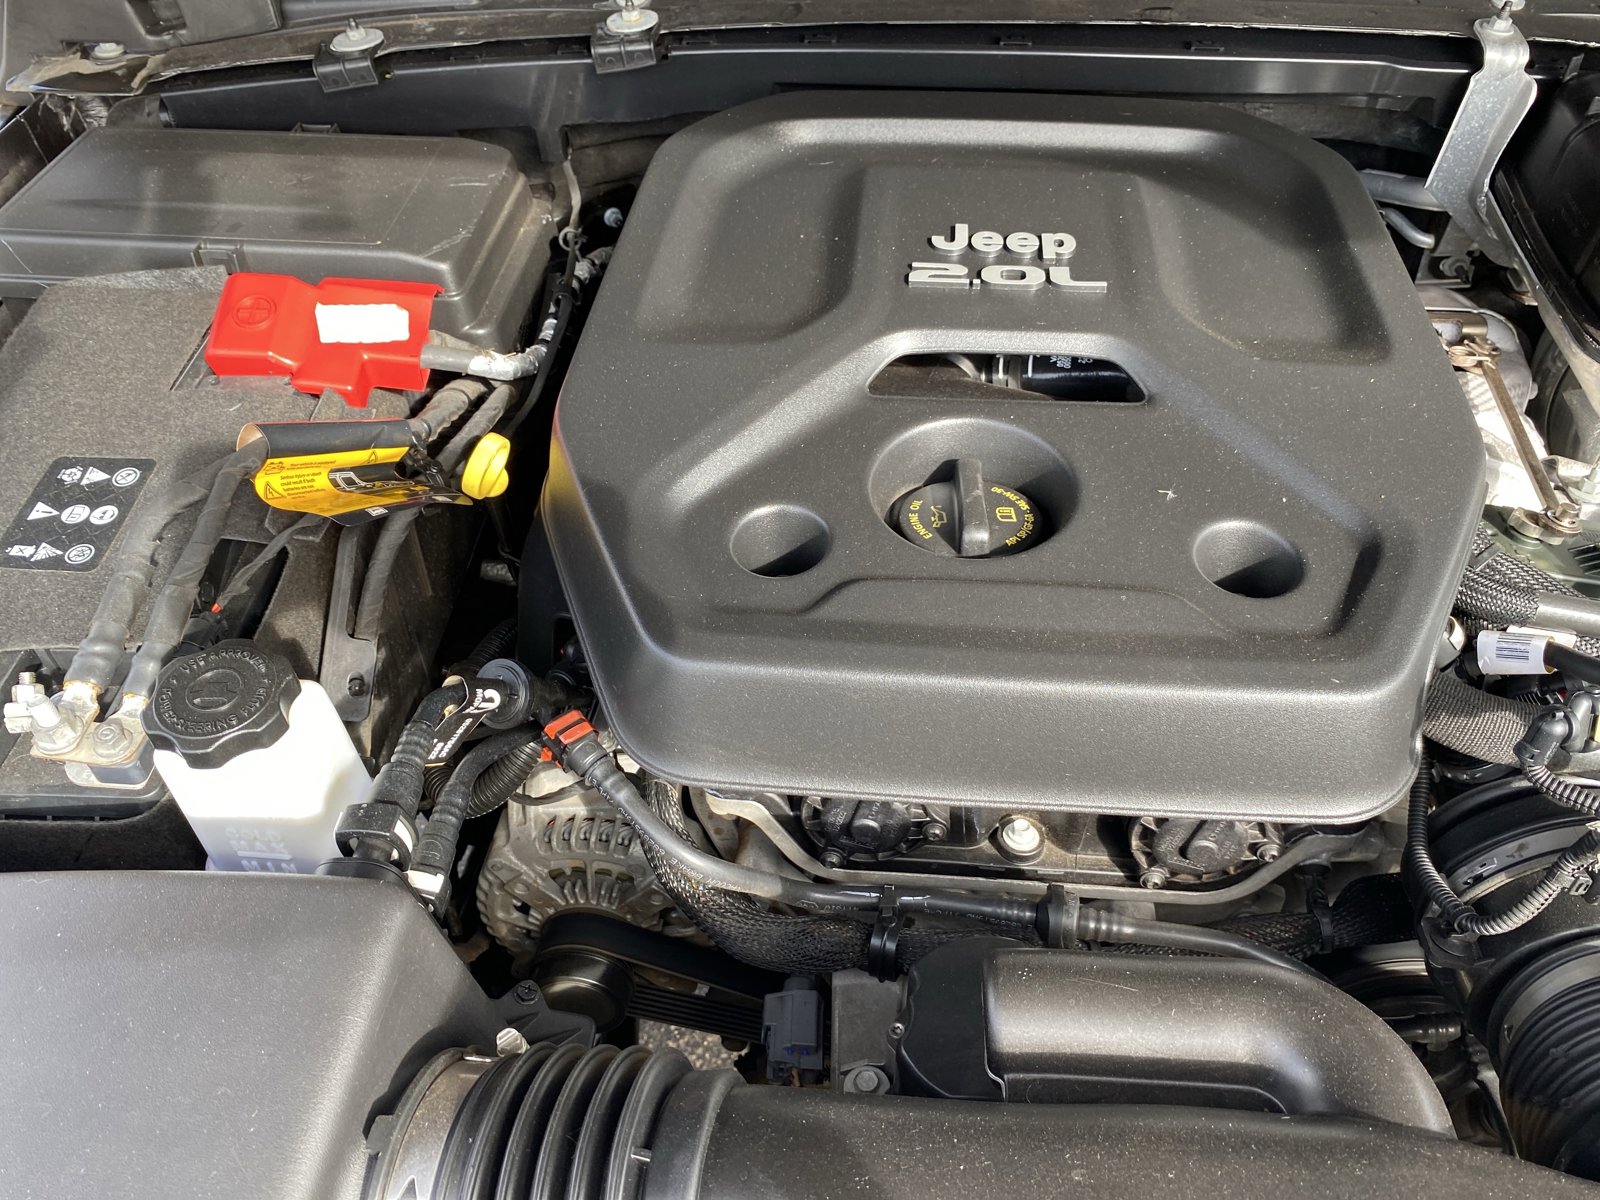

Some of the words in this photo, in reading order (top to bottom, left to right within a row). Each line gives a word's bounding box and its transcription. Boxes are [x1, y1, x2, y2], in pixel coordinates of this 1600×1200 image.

[930, 223, 1077, 264] Jeep
[908, 262, 1108, 293] 2.0L
[910, 500, 923, 511] OIL
[908, 512, 933, 540] ENGINE
[179, 653, 207, 674] USE
[208, 649, 267, 674] APPROVED
[158, 687, 177, 725] POWER
[174, 713, 239, 734] STEERING
[239, 687, 267, 717] FLUID
[240, 859, 298, 873] MIN
[669, 855, 704, 881] BRAKE
